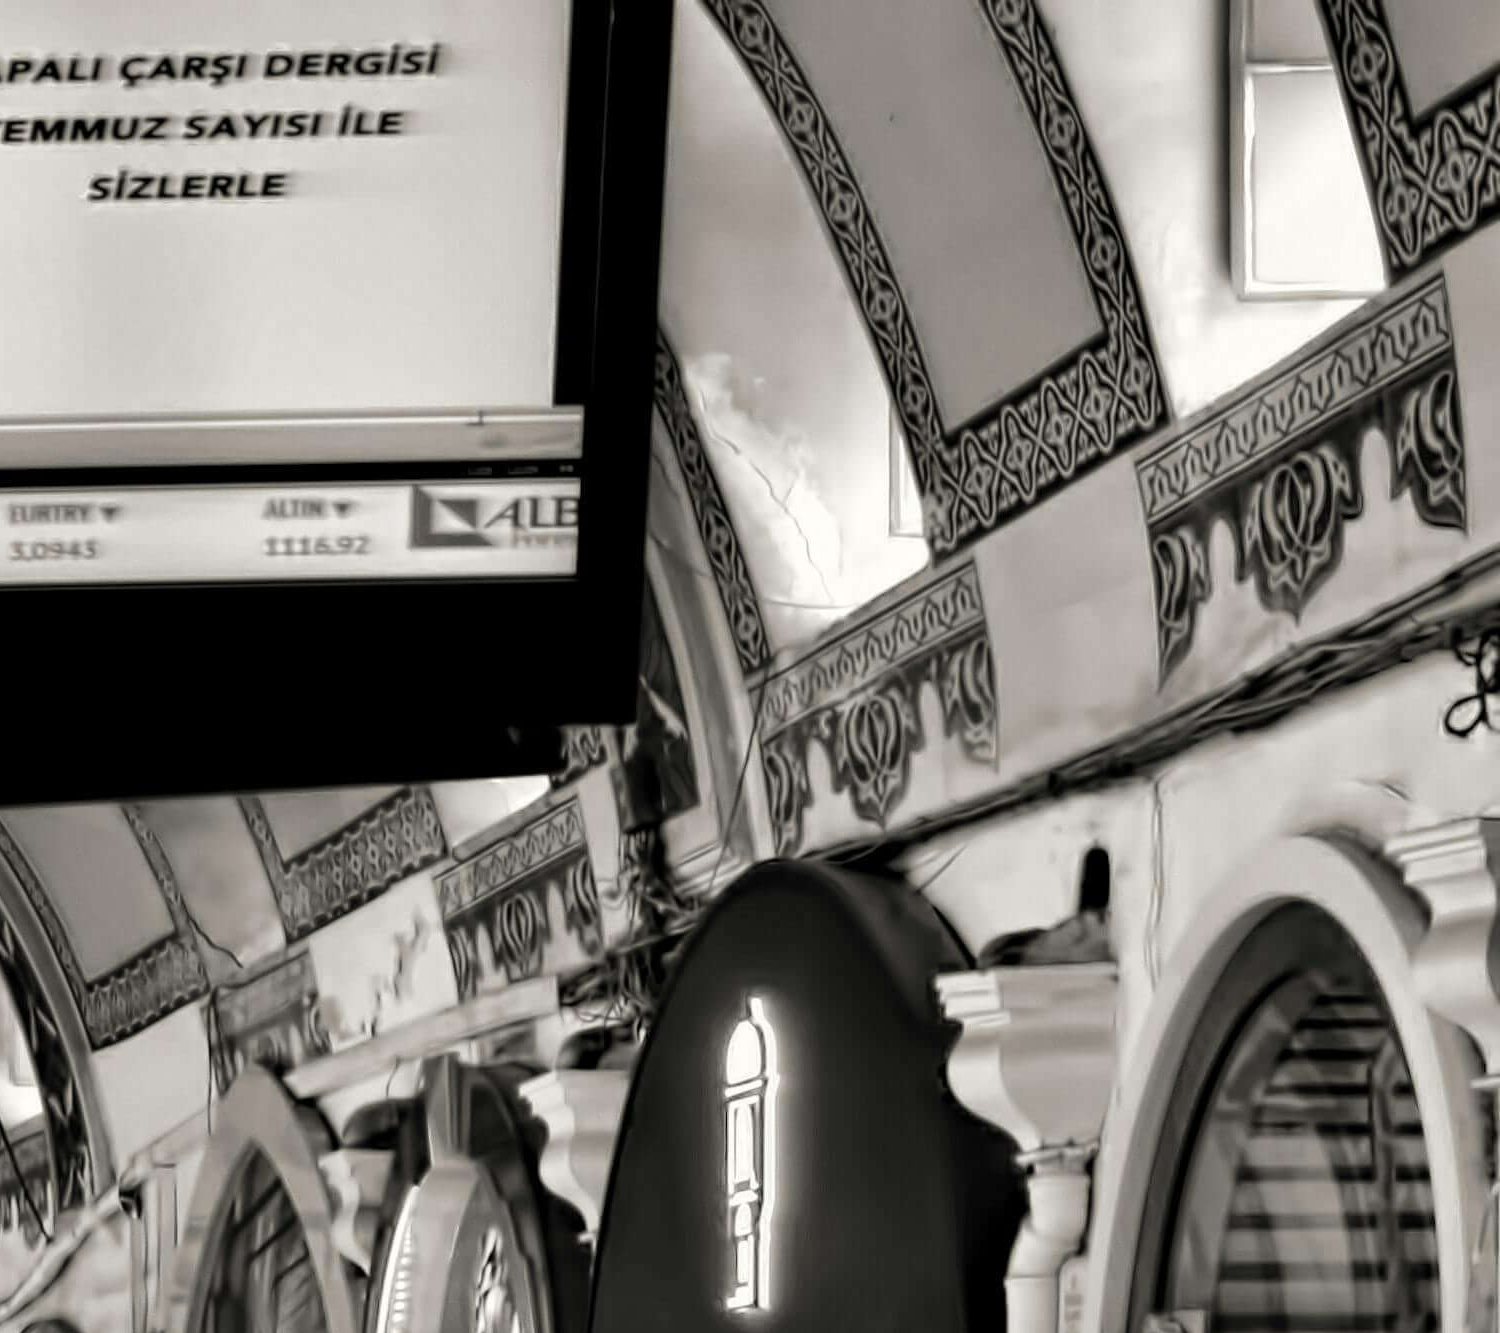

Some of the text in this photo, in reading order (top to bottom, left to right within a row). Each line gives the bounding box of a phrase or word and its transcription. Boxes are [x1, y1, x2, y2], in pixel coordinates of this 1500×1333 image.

[119, 53, 248, 87] ÇARŞI
[263, 42, 442, 79] DERGİSİ
[182, 110, 323, 140] SAYISI
[338, 102, 404, 136] İLE
[87, 169, 288, 201] SİZLERLE
